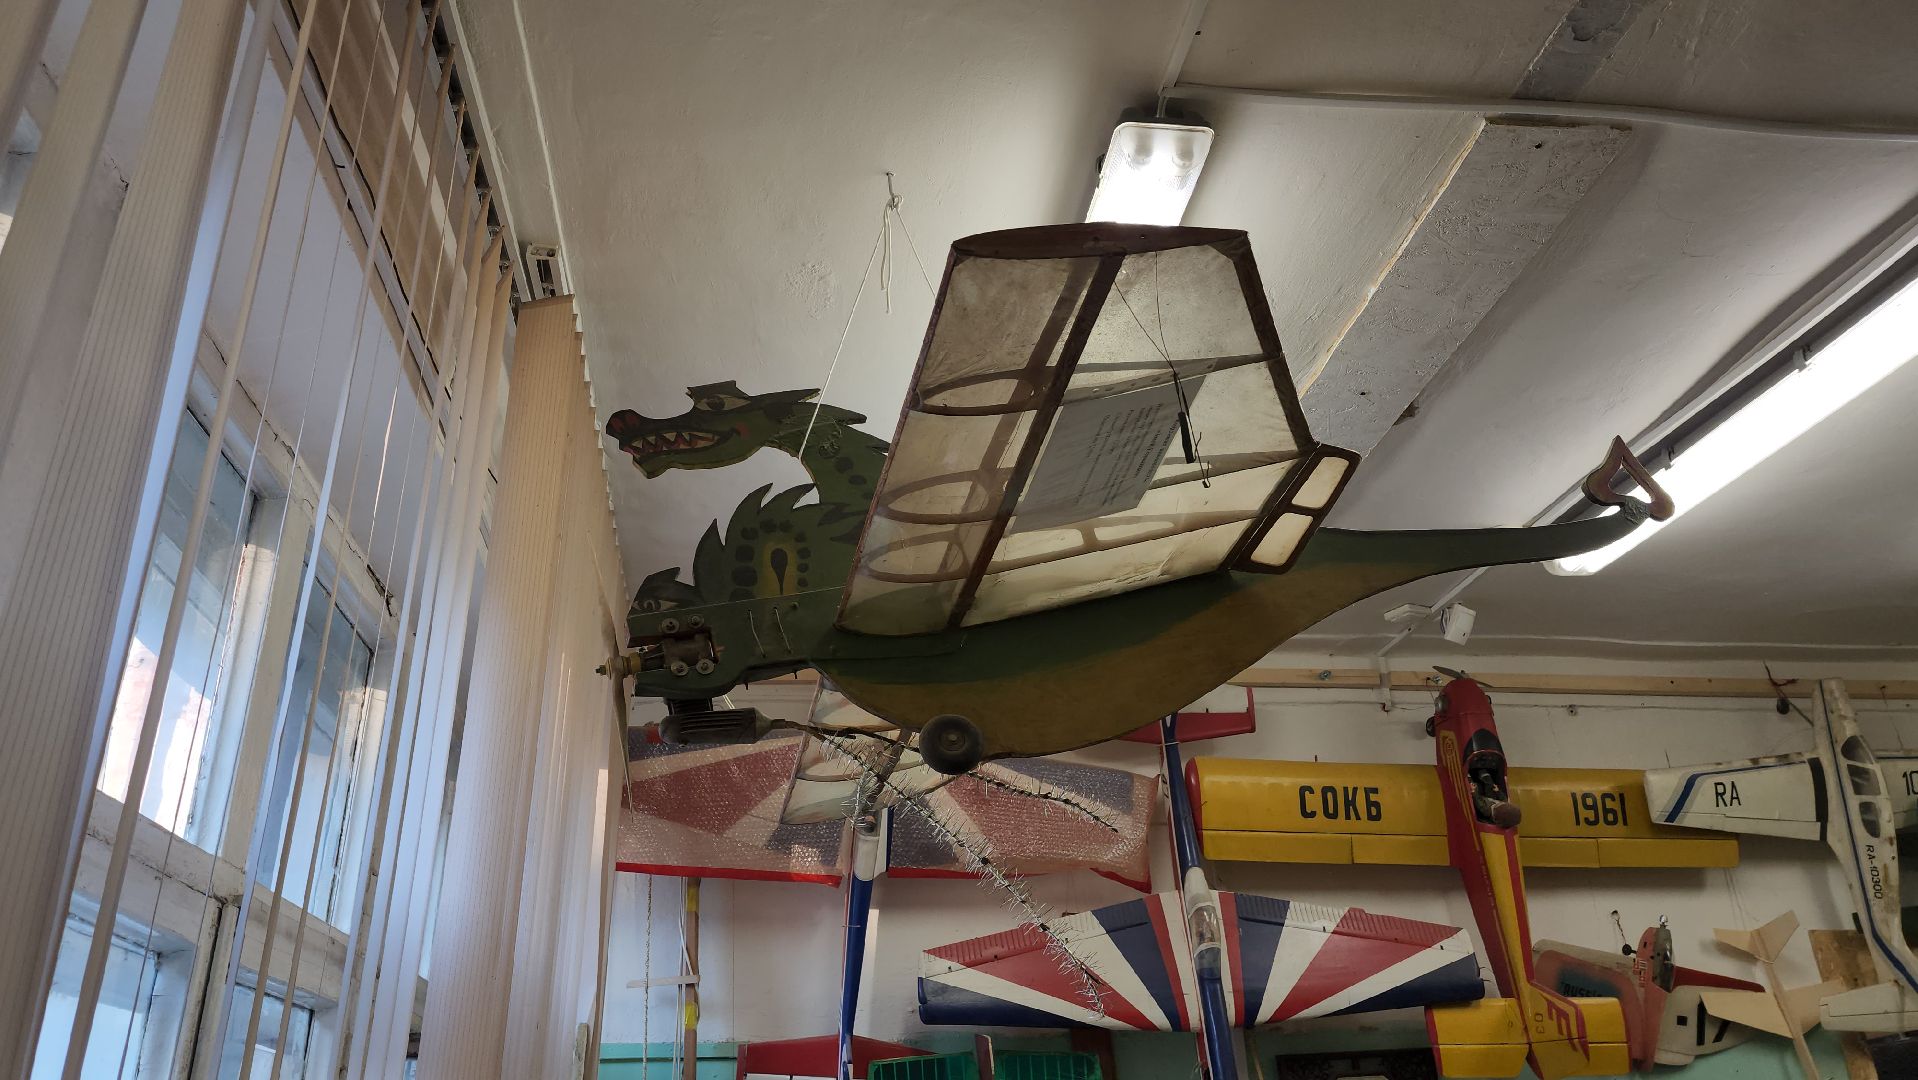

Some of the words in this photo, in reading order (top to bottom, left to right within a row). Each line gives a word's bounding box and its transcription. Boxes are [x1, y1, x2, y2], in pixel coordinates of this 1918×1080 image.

[1298, 785, 1382, 821] СОКБ
[1570, 792, 1628, 826] 1961
[1714, 781, 1742, 808] RA
[1865, 844, 1884, 900] RA-10300
